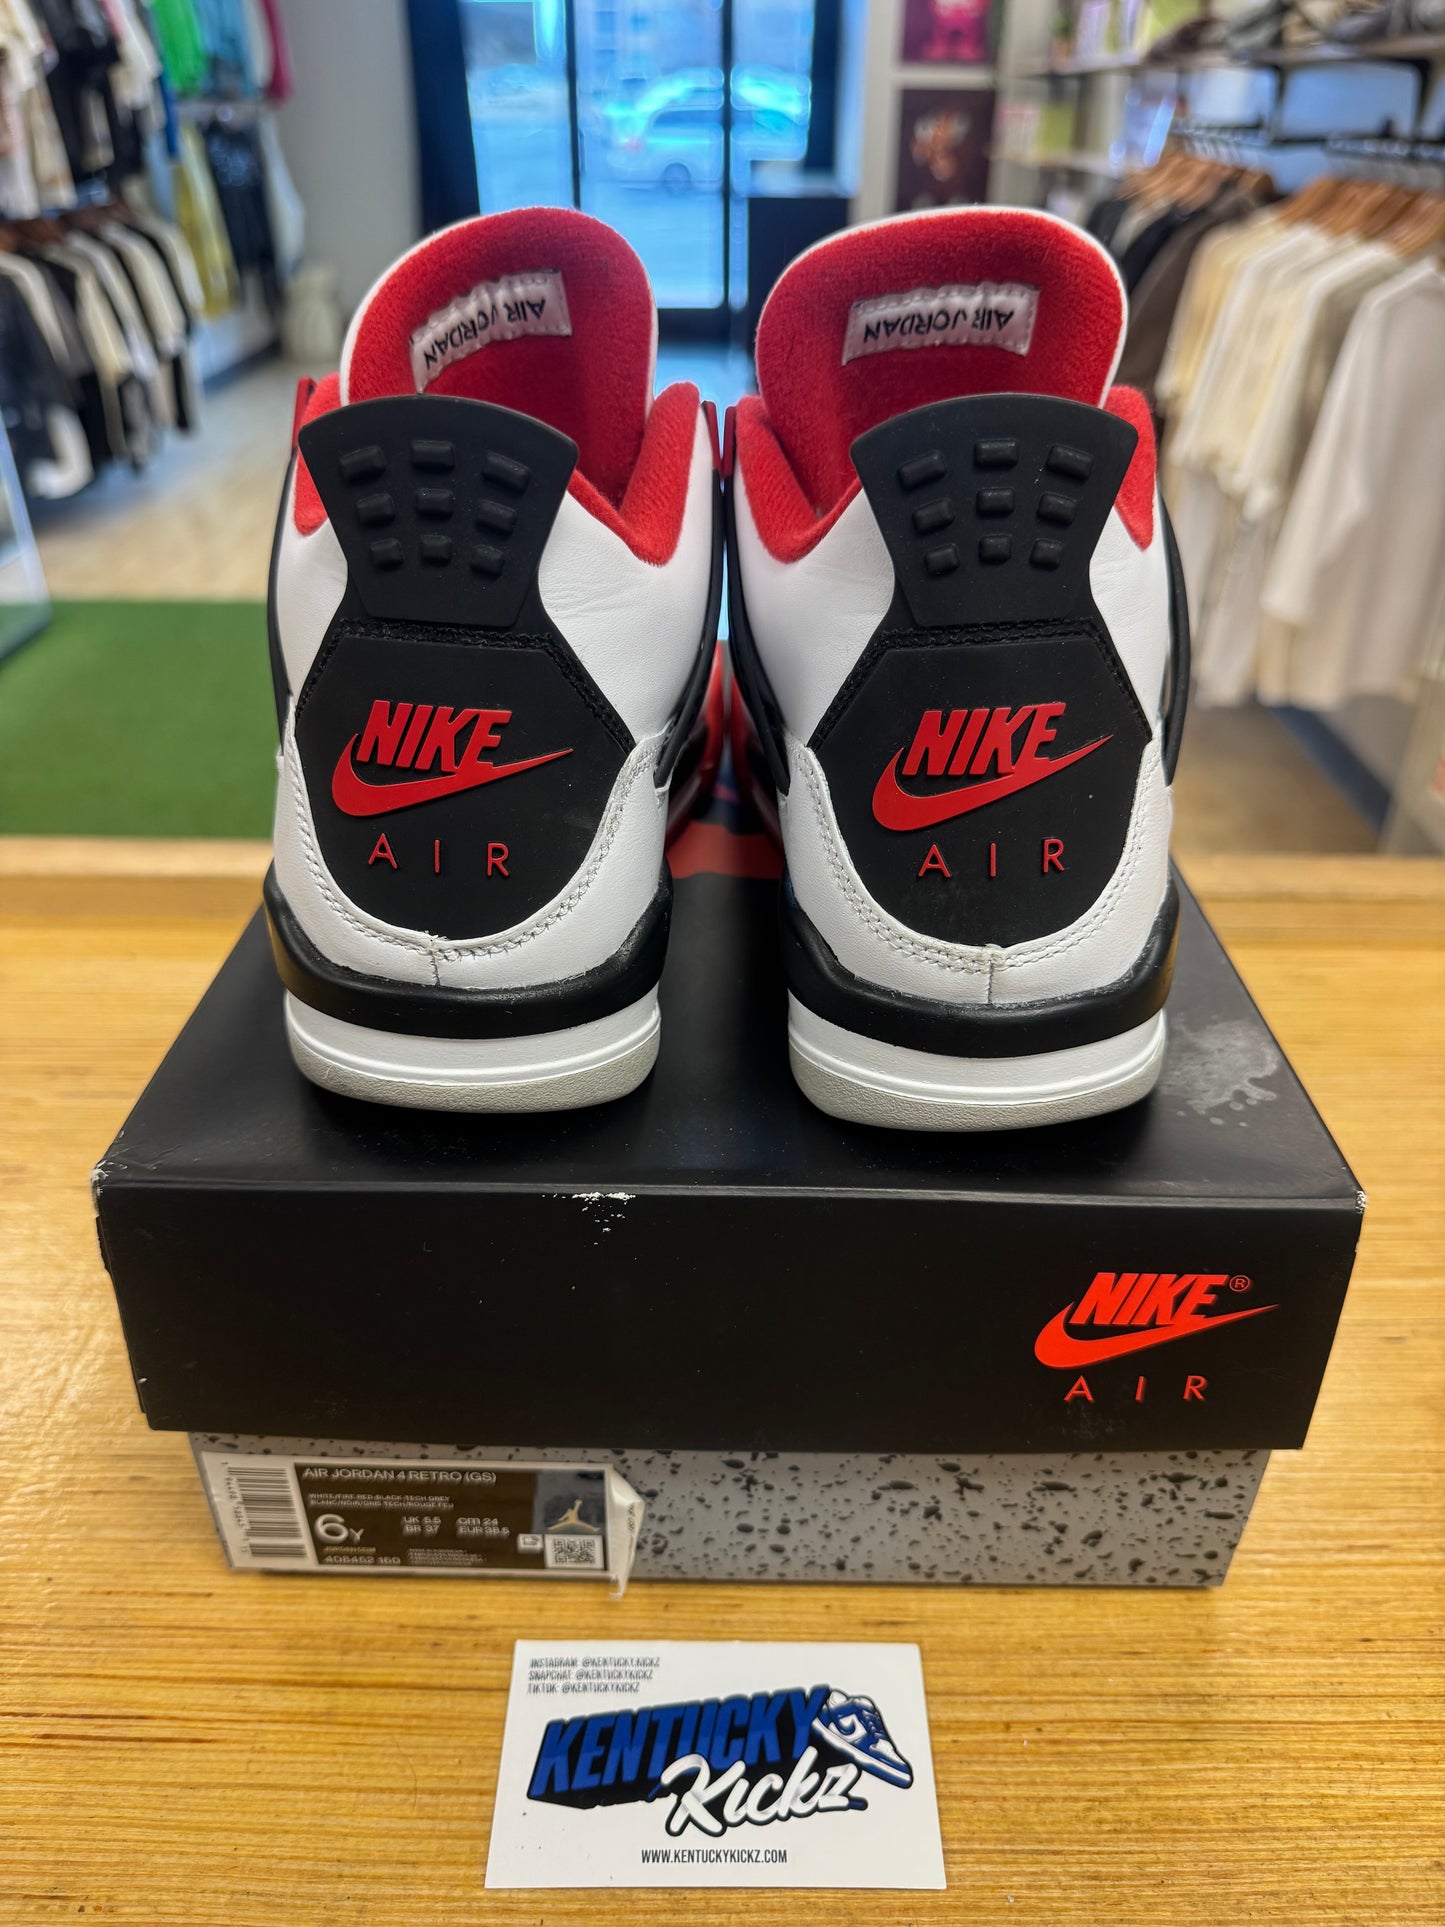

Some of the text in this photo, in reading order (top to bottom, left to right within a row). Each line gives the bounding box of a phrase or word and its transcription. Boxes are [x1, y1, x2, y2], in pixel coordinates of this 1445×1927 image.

[423, 299, 547, 371] AIR JORDAN
[863, 308, 1014, 343] AIR JORDAN
[356, 700, 513, 773] NIKE
[902, 702, 1067, 776] NIKE
[368, 833, 511, 877] AIR
[918, 837, 1065, 878] AIR
[1068, 1271, 1230, 1326] NIKE
[1063, 1375, 1208, 1402] AIR
[303, 1467, 497, 1485] AIR JORDAN 4 RETRO (GS)
[403, 1516, 420, 1524] UK
[404, 1524, 440, 1534] BR 37
[458, 1525, 510, 1536] EUR 38.5
[482, 1518, 499, 1526] 24
[530, 1686, 831, 1798] KENTUCKY
[660, 1744, 859, 1838] Kickz
[641, 1849, 788, 1864] WWW.KENTUCKYKICKZ.COM
